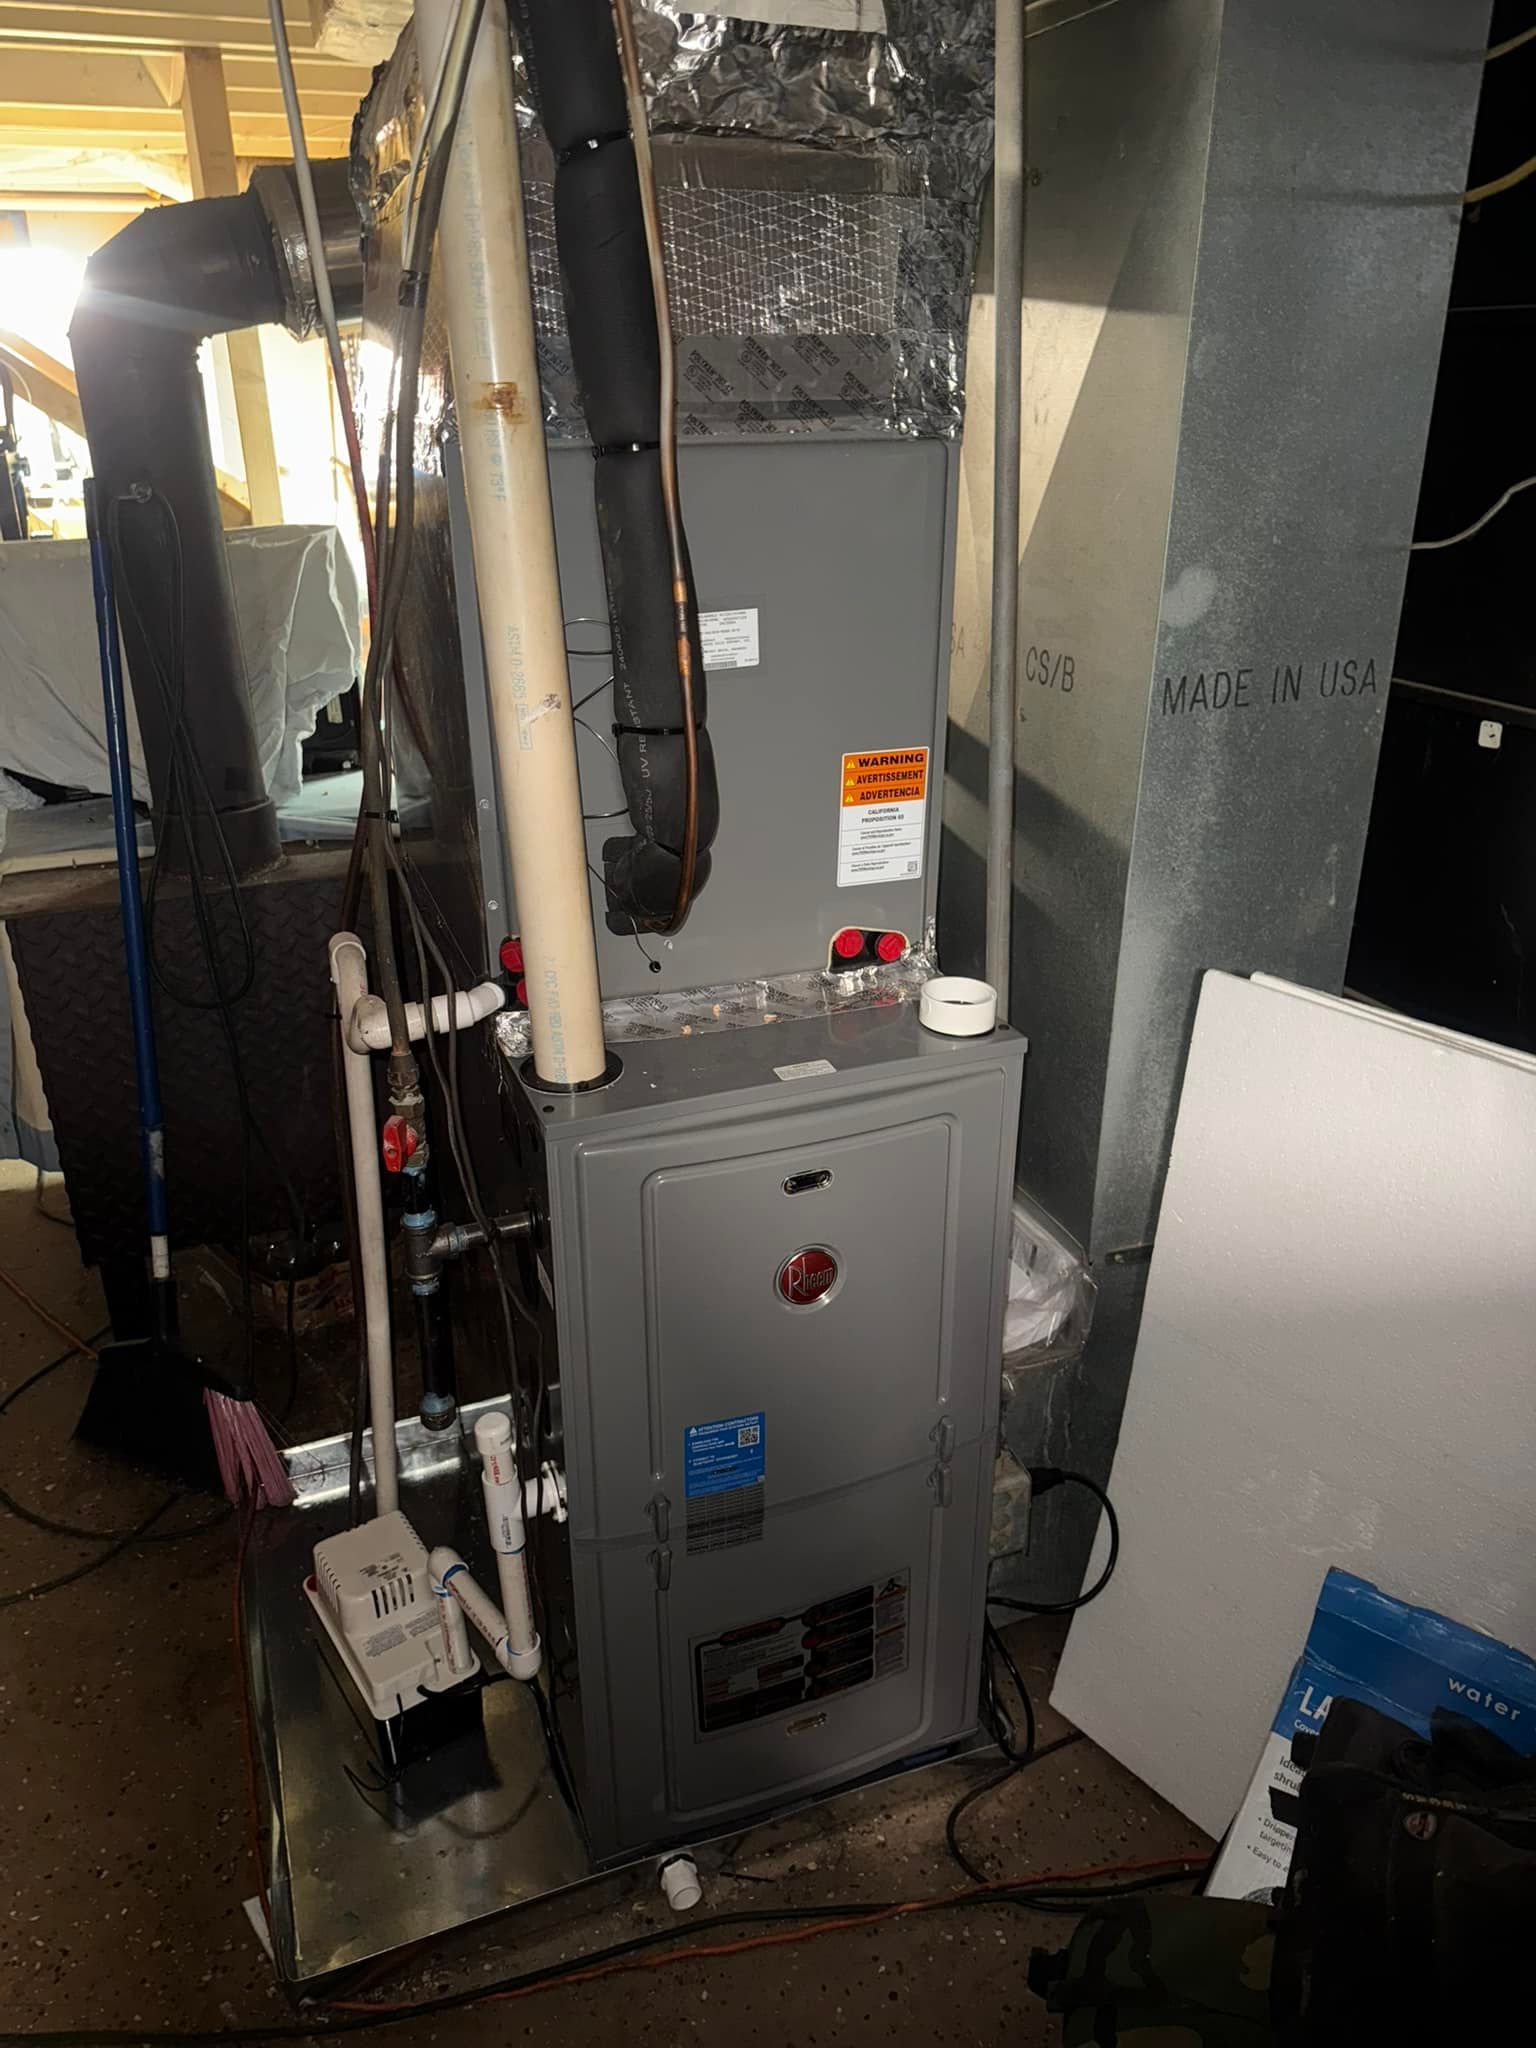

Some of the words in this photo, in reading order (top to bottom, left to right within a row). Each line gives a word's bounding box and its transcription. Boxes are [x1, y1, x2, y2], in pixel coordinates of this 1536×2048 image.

[1025, 645, 1076, 693] CS/B
[1162, 668, 1253, 717] MADE
[1272, 664, 1303, 704] IN
[1320, 658, 1377, 698] USA
[623, 682, 647, 752] REISTANT
[640, 757, 651, 778] UV
[856, 769, 925, 785] AVERTISSEMENT
[858, 753, 925, 768] WARNING
[859, 786, 920, 802] ADVERTENCIA
[788, 1256, 834, 1298] Rheem
[1448, 1677, 1521, 1722] water
